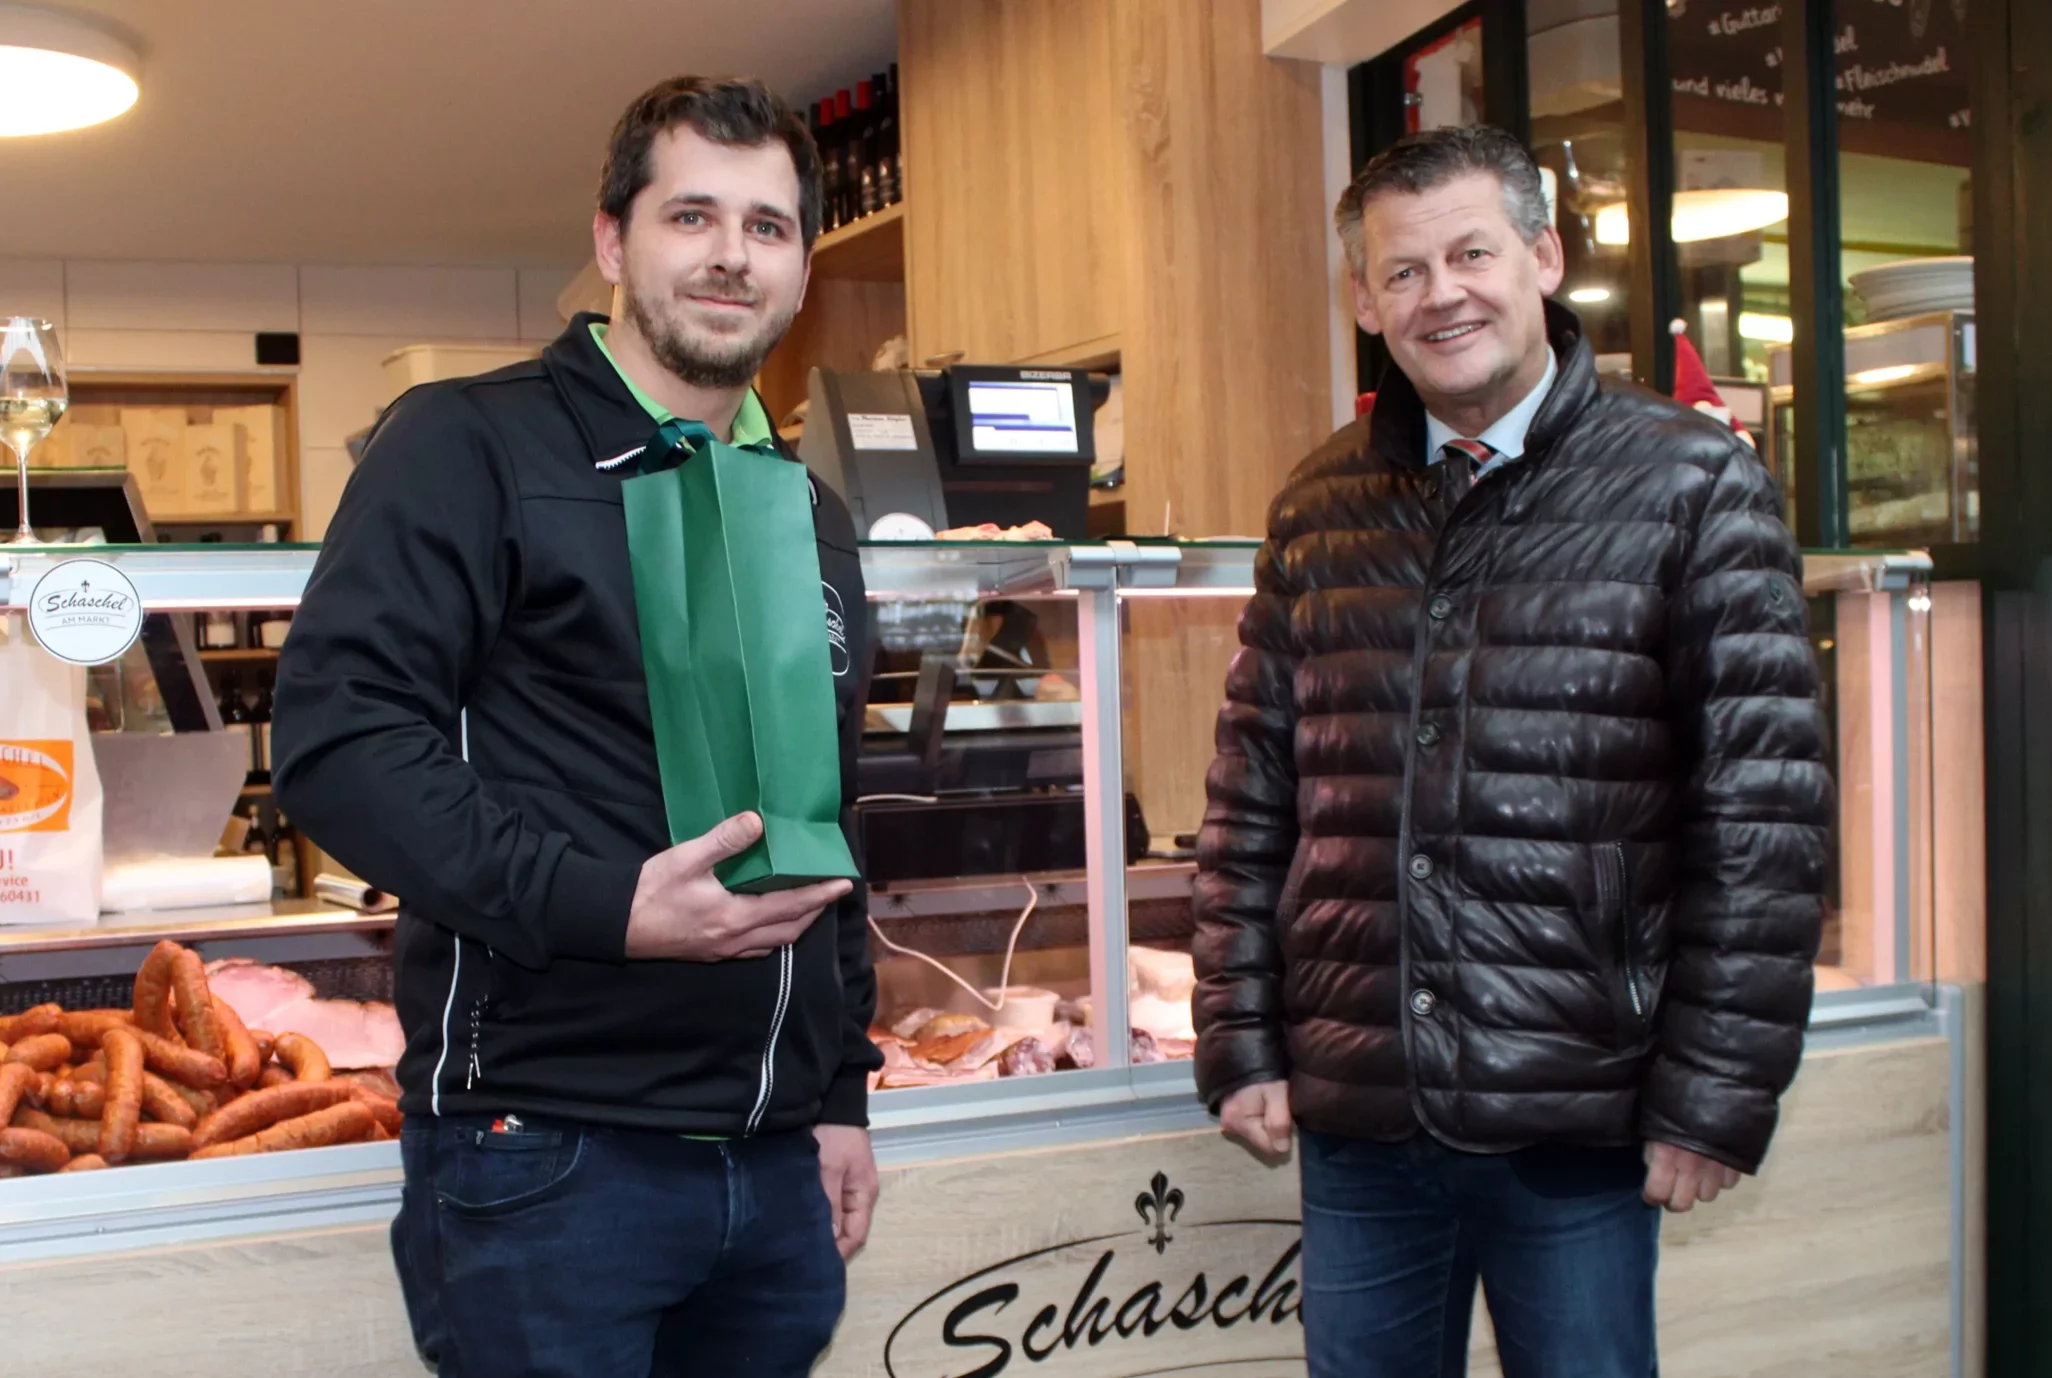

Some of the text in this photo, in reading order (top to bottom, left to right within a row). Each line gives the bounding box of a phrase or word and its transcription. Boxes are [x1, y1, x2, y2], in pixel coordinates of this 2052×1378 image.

[1715, 76, 1768, 104] vieles
[46, 592, 128, 613] Schaschel
[62, 616, 110, 625] AM MARKT
[940, 1236, 1304, 1378] Schasch
